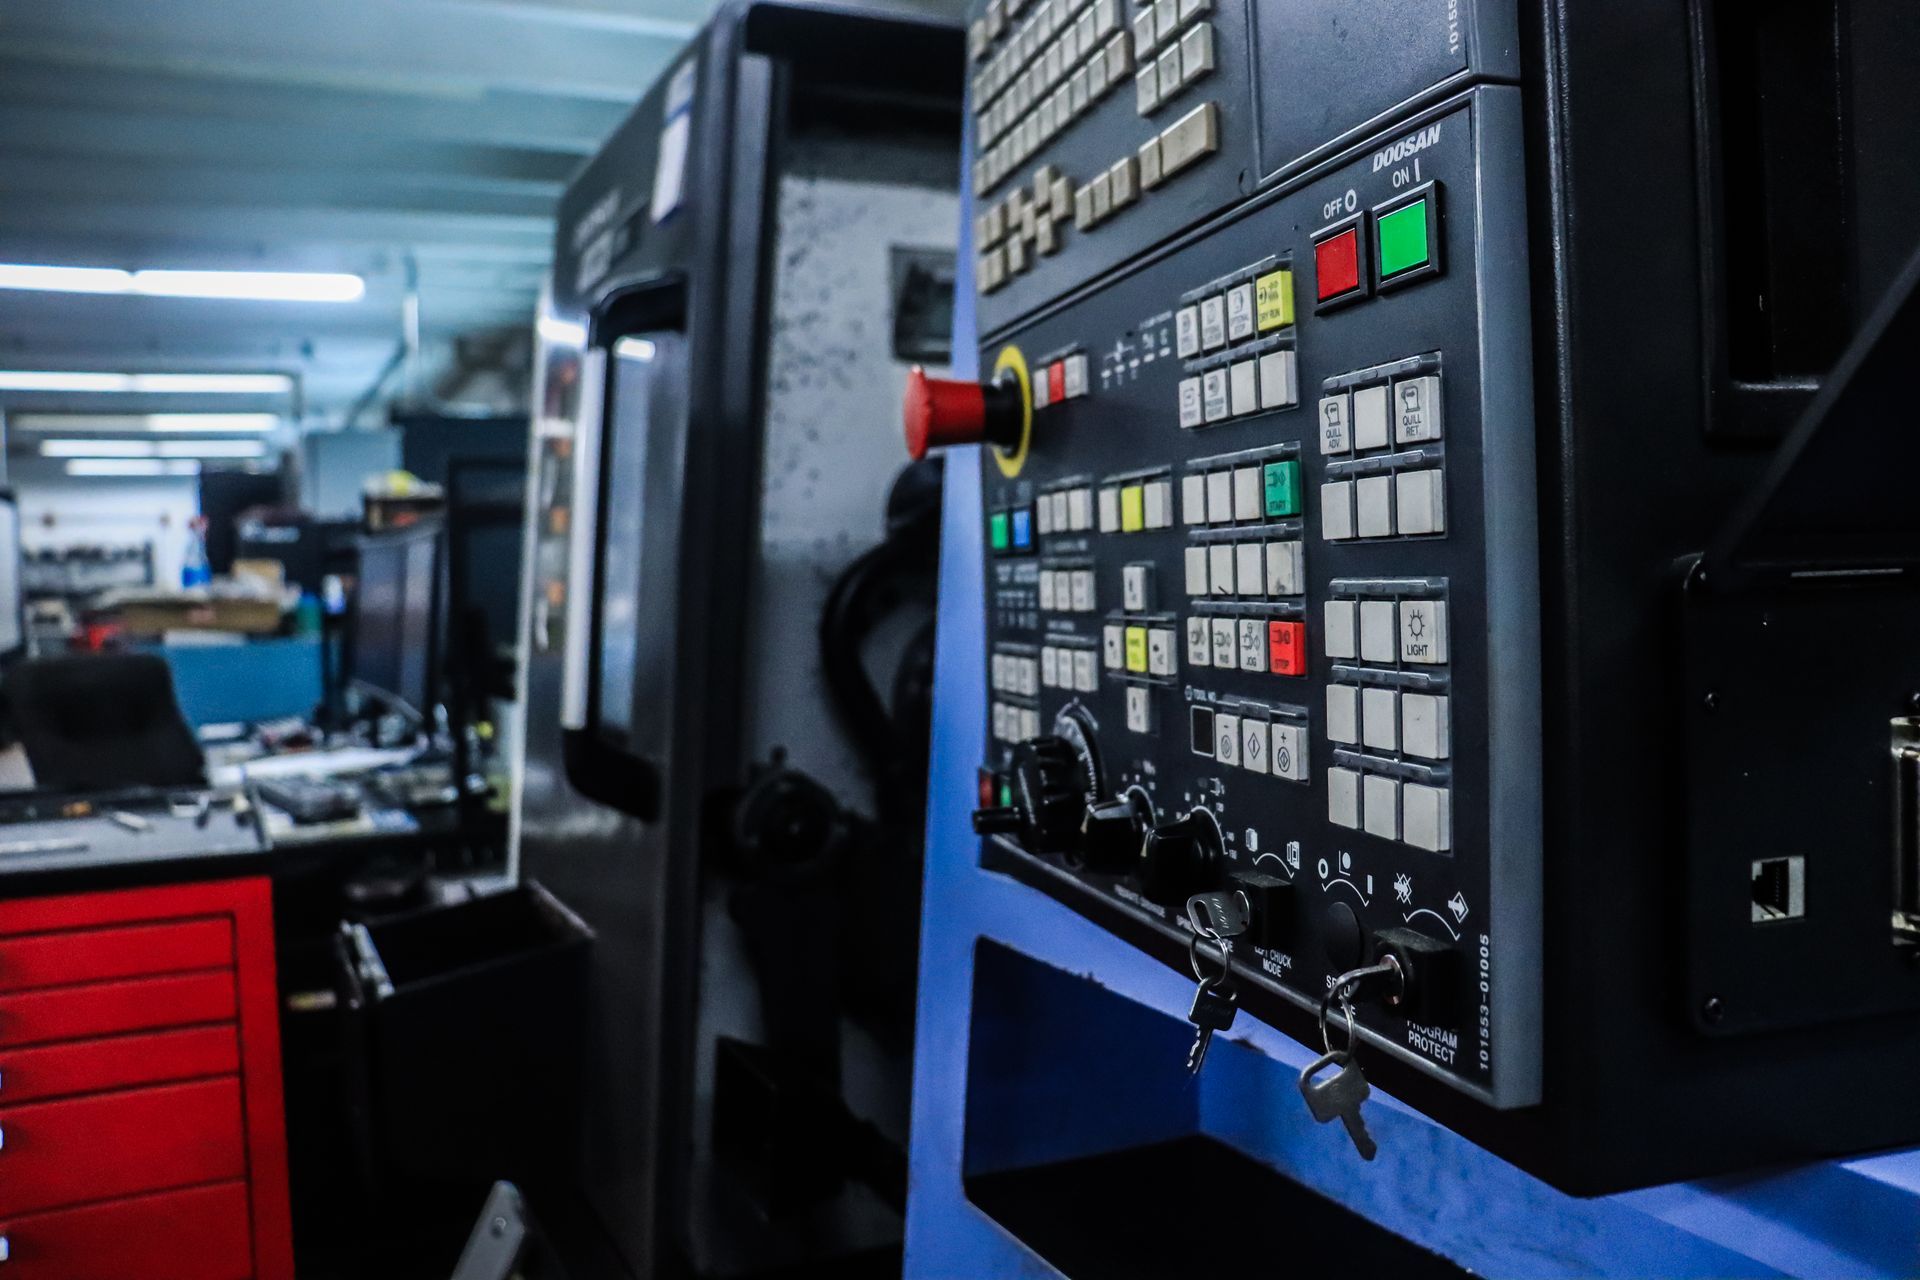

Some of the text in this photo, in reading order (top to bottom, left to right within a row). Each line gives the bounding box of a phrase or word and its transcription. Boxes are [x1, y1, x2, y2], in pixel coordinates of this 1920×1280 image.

[1373, 123, 1441, 173] DOOSAN
[1392, 166, 1410, 188] ON
[1323, 198, 1342, 219] OFF
[1403, 415, 1422, 426] QUILL
[1326, 428, 1342, 439] QUILL
[1407, 644, 1428, 656] LIGHT
[1263, 957, 1282, 978] MODE
[1270, 949, 1292, 968] CHUCK
[1480, 934, 1490, 1070] 101553-01005
[1408, 1030, 1456, 1064] PROTECT
